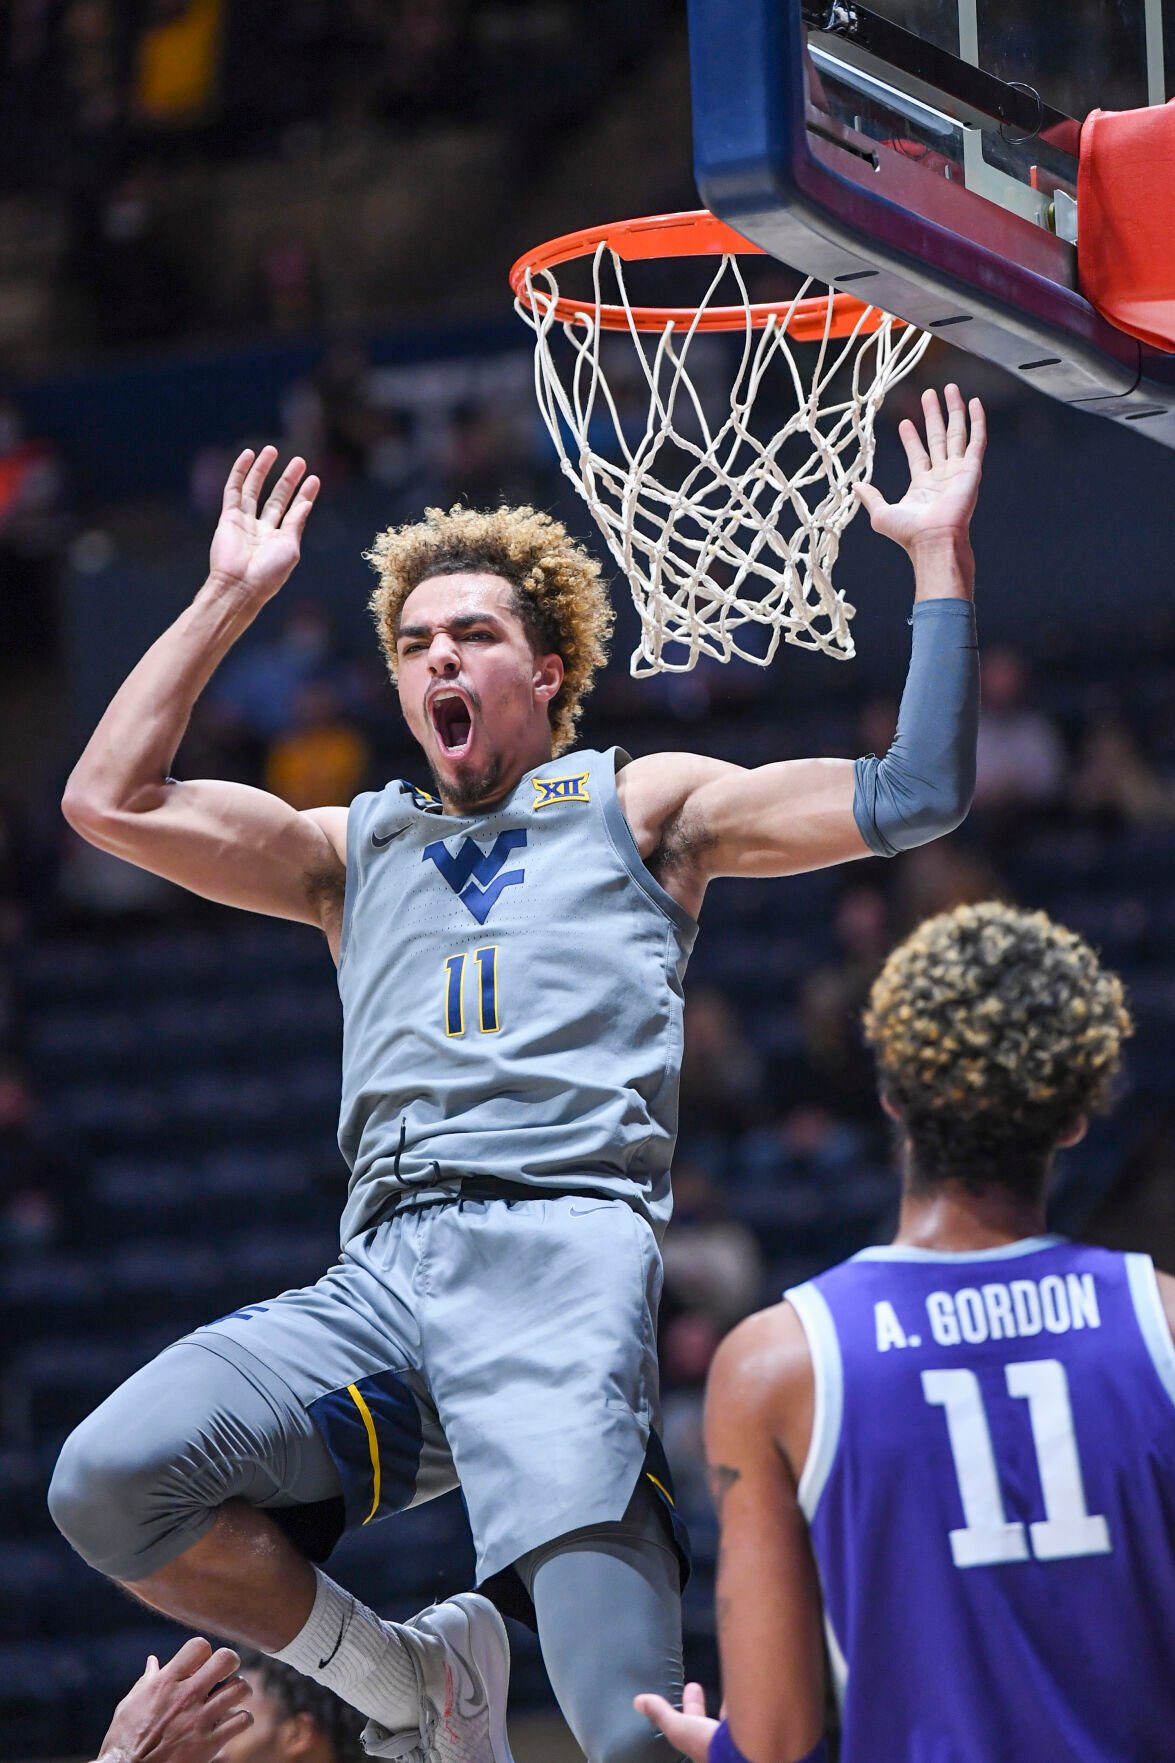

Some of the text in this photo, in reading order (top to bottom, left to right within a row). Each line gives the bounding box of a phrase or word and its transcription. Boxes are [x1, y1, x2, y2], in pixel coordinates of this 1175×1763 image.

[536, 776, 585, 803] XII
[444, 945, 500, 1037] 11
[874, 1273, 1101, 1352] A. GORDON
[921, 1359, 1112, 1568] 11
